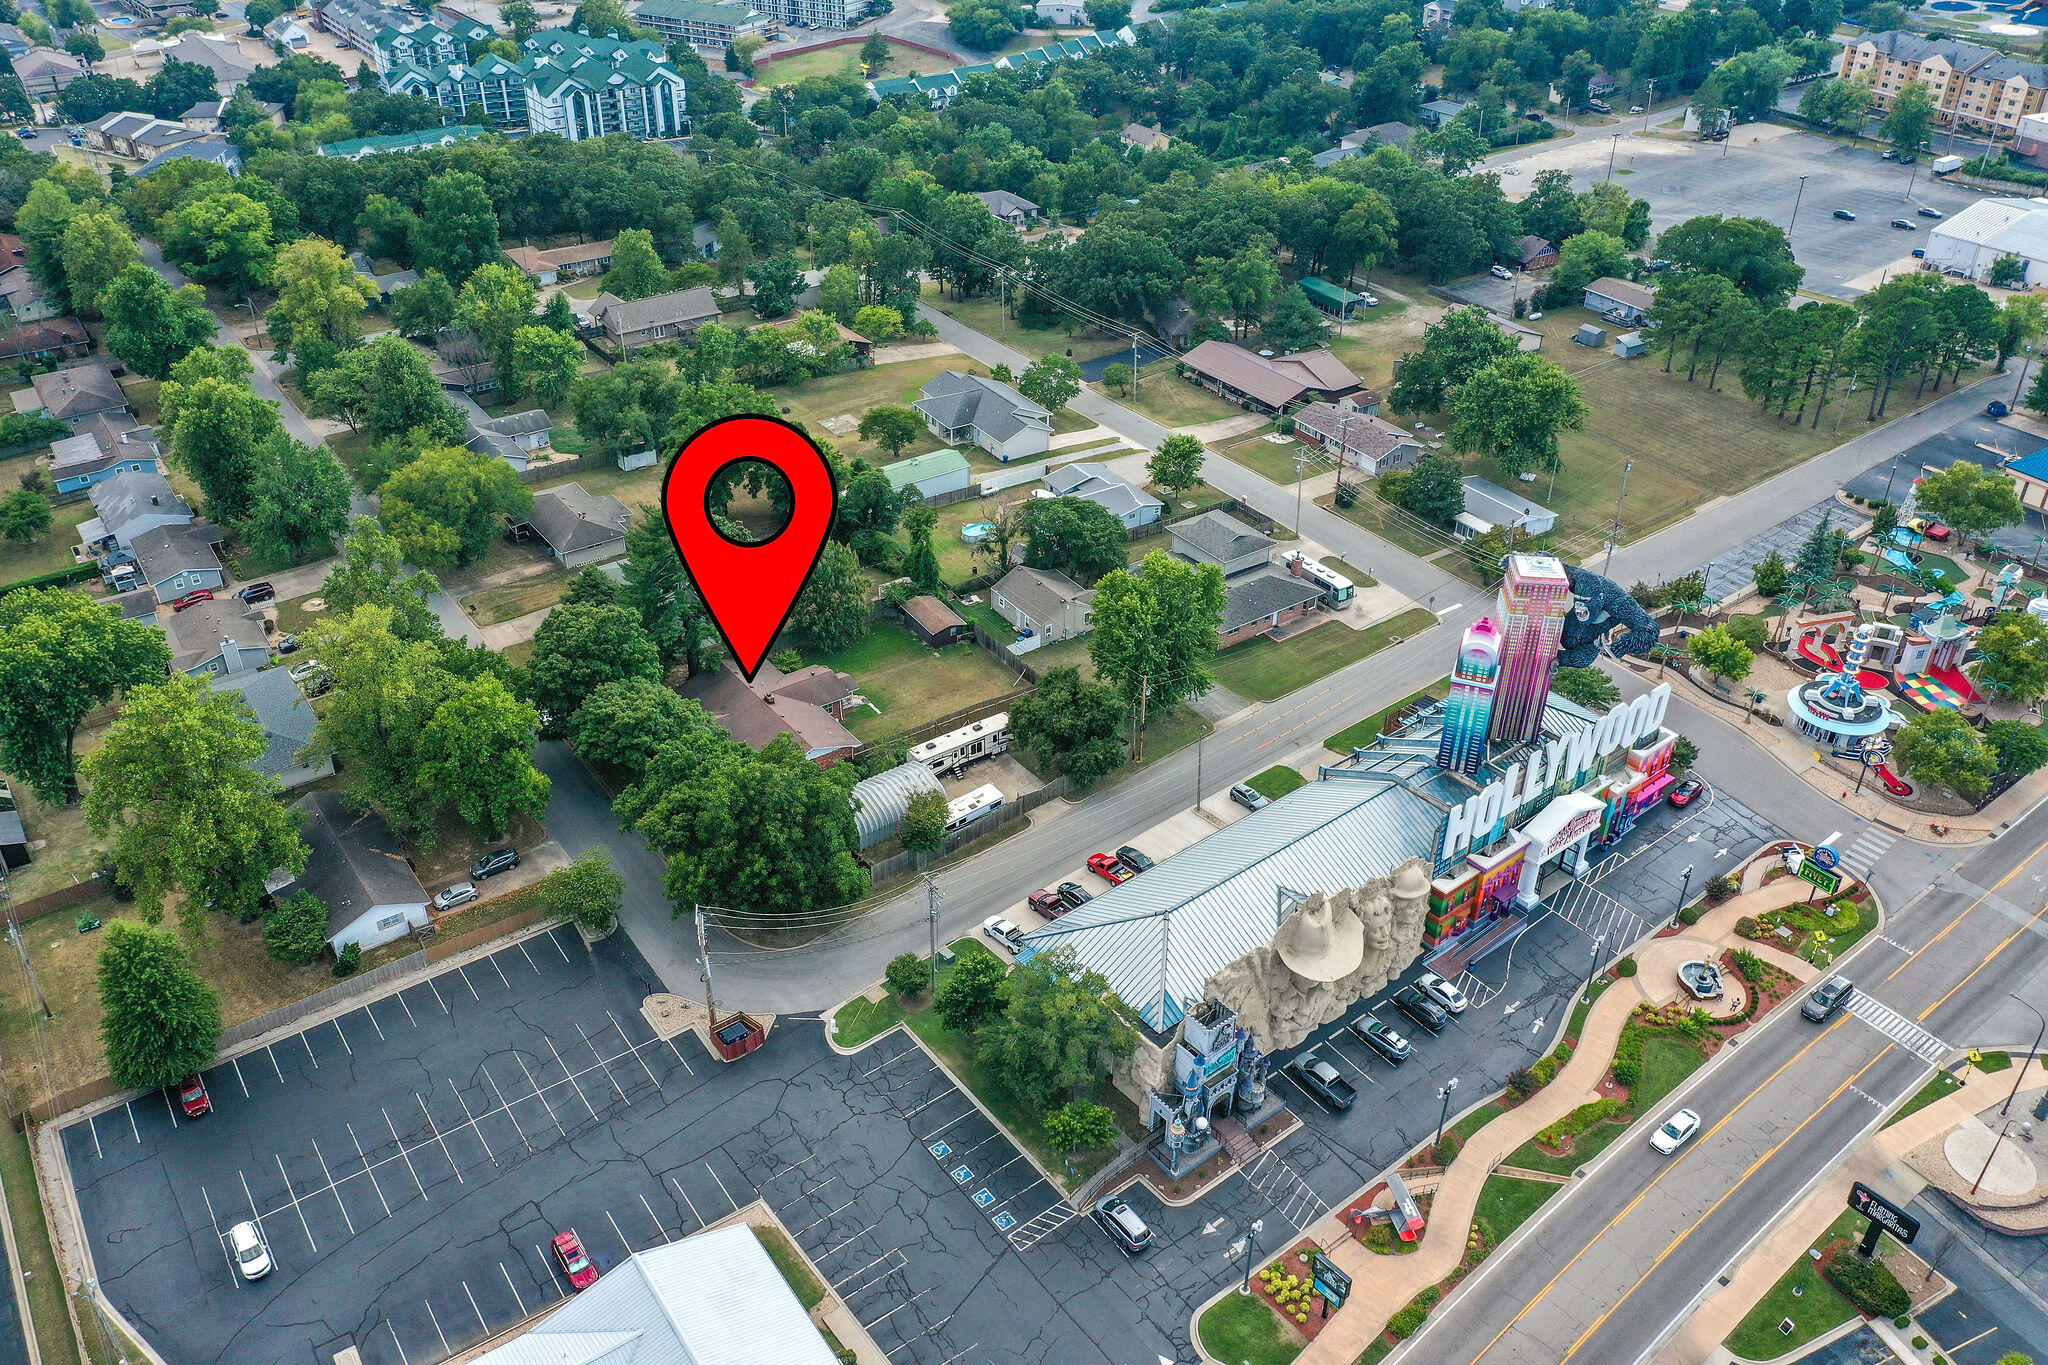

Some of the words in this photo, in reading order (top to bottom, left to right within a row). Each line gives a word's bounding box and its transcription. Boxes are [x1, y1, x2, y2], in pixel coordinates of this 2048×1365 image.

[1442, 682, 1671, 860] HOLLYWOOD
[1867, 1206, 1908, 1238] MARGARITAS
[1870, 1200, 1898, 1223] FLAMING
